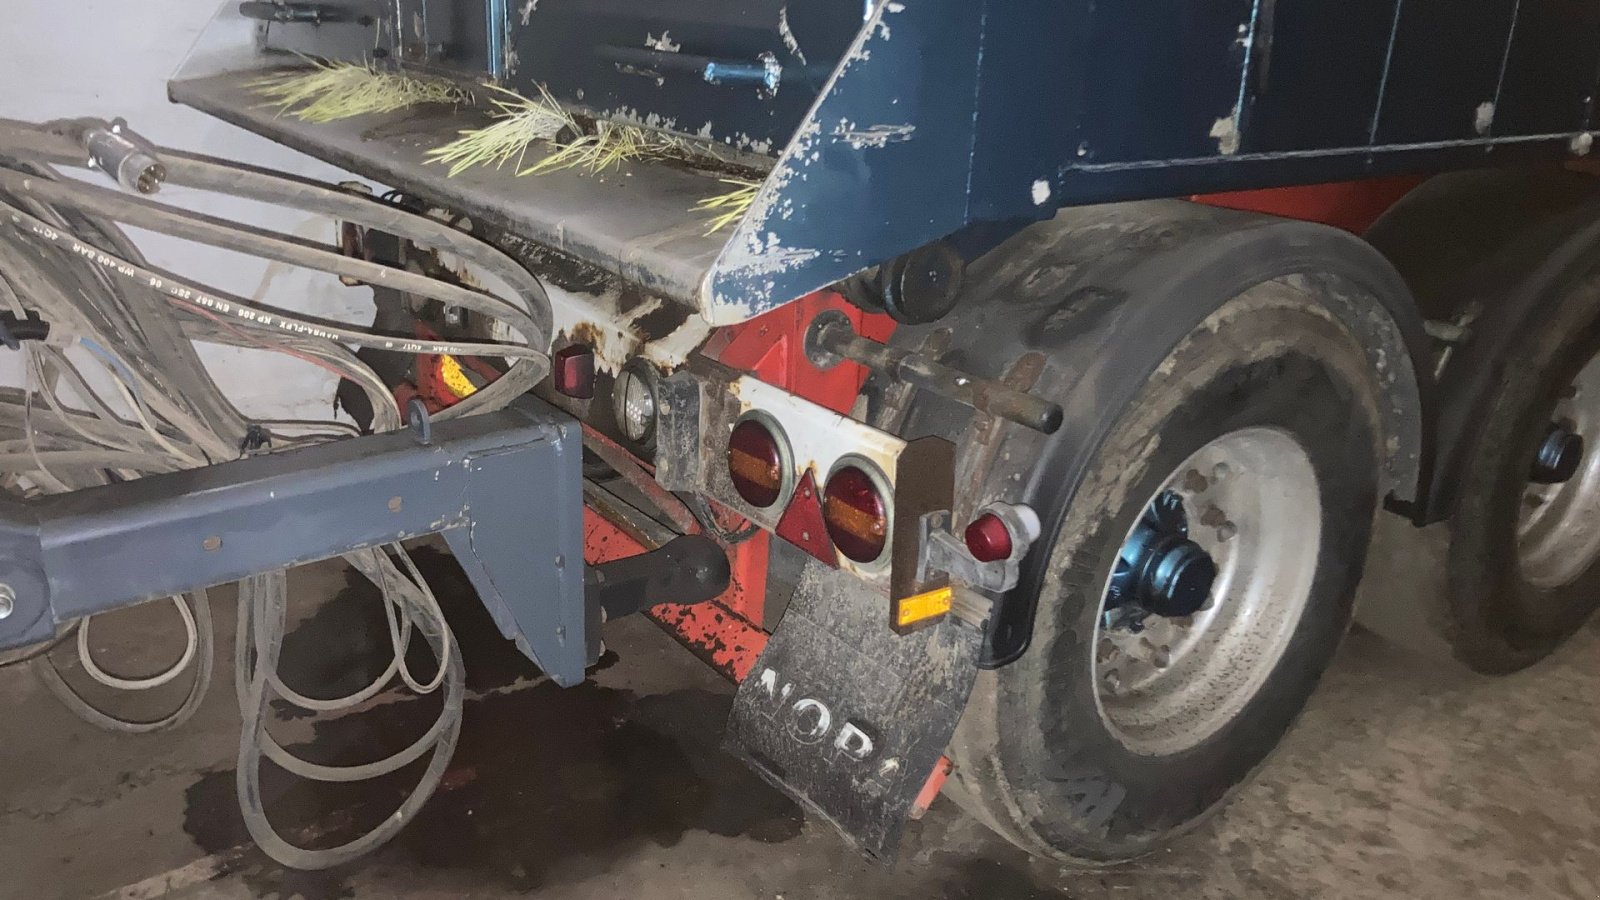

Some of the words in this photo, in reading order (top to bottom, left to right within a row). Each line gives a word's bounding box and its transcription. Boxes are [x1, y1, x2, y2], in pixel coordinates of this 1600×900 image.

[73, 243, 96, 260] BAR
[97, 255, 116, 268] 400
[118, 266, 135, 278] WP
[215, 302, 230, 313] EN
[257, 315, 272, 325] KP
